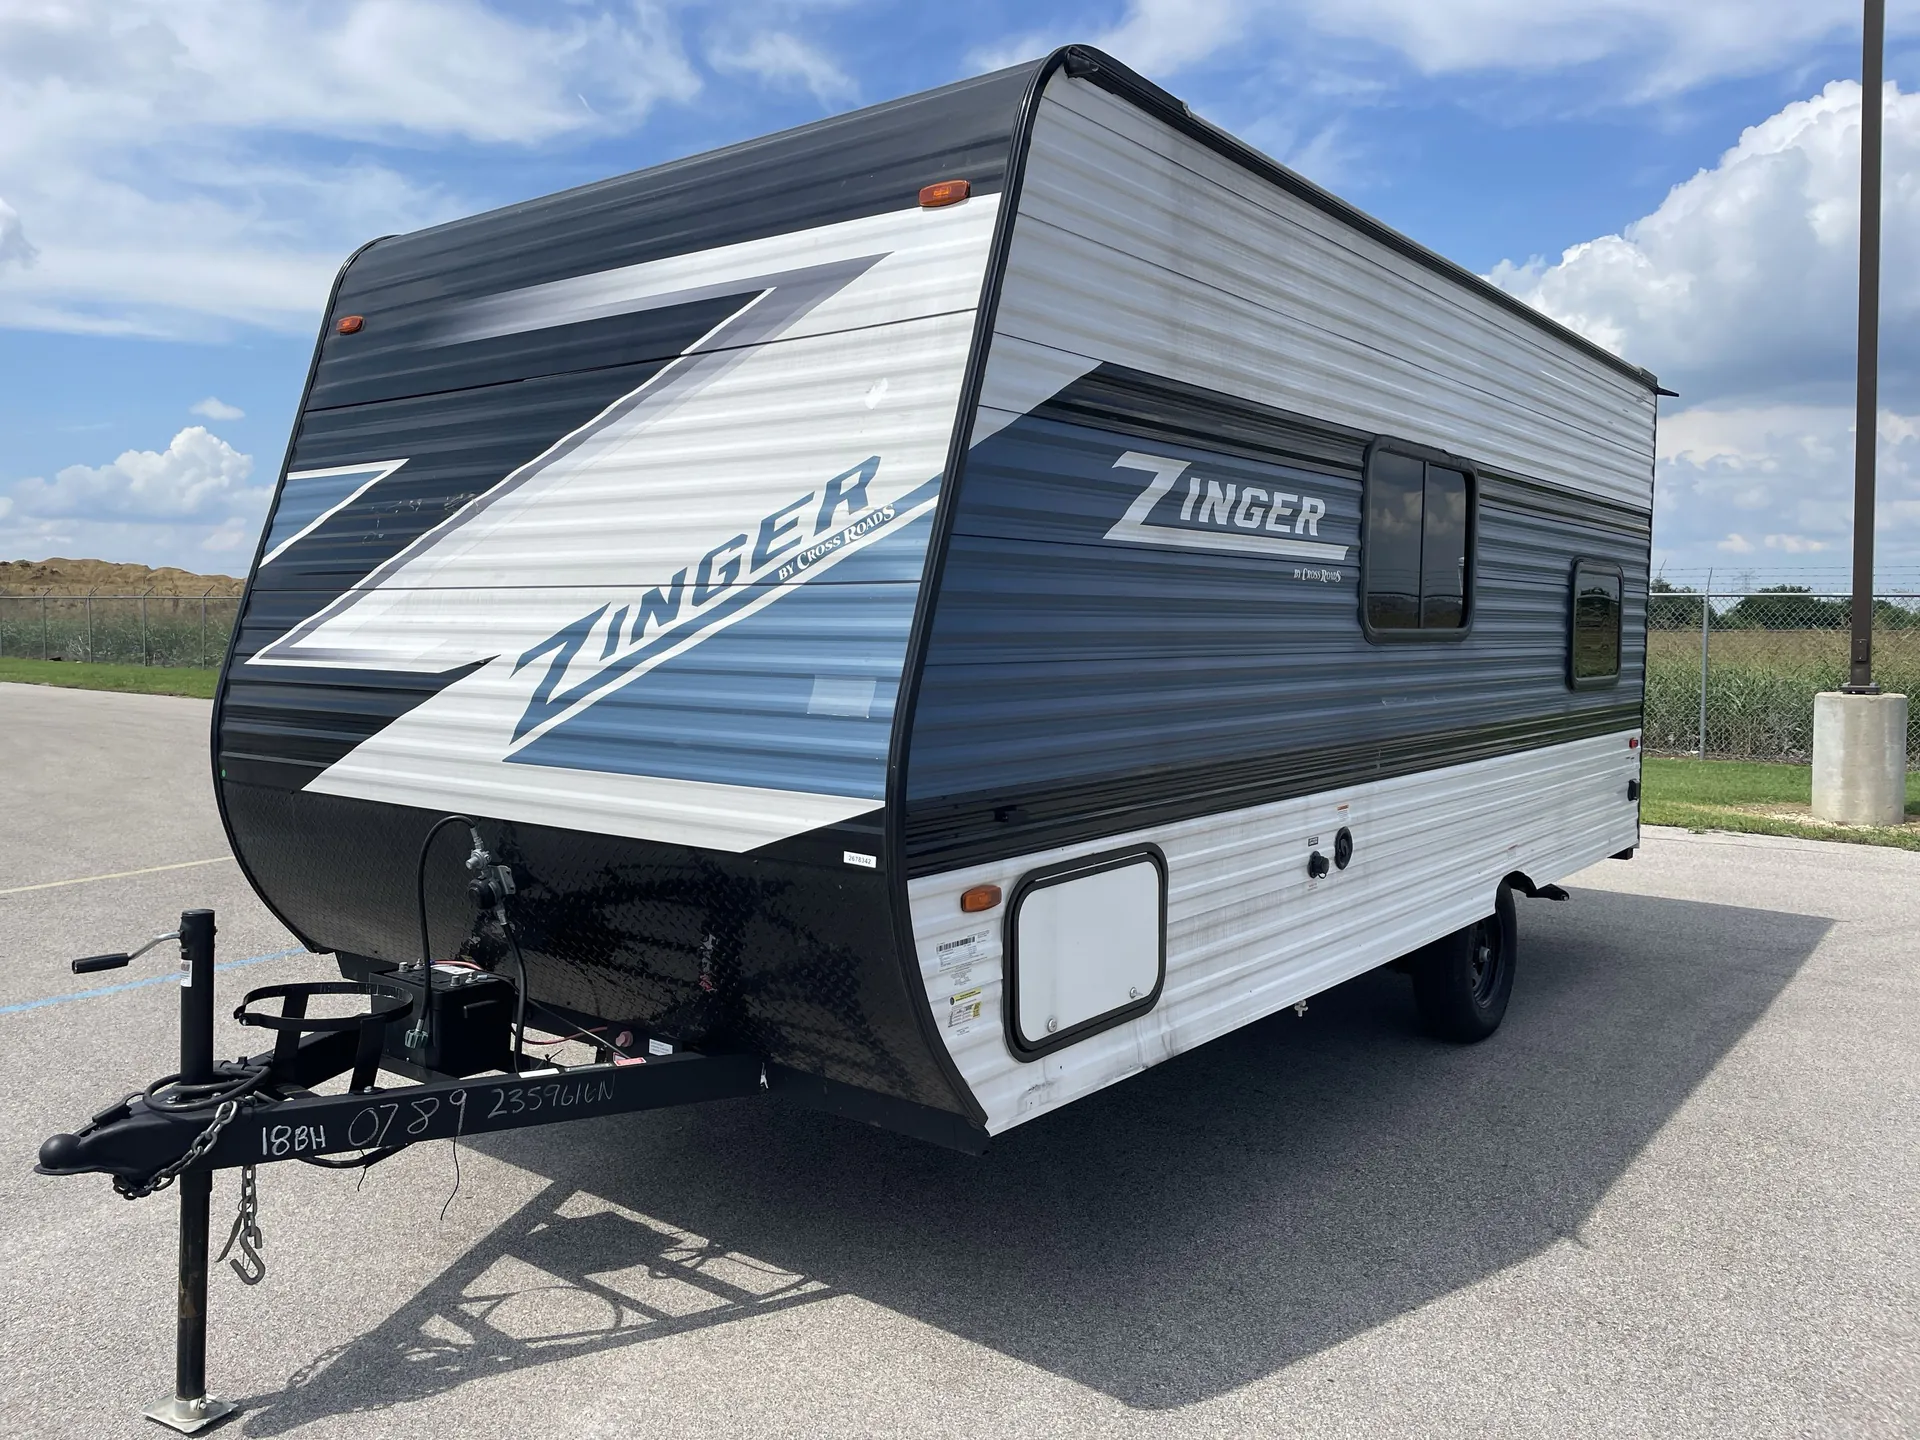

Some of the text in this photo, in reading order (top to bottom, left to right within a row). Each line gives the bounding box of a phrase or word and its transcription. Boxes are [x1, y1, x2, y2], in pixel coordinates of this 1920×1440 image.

[1103, 451, 1349, 560] ZINGER
[509, 456, 881, 745] ZINGER
[778, 562, 794, 580] BY
[262, 1125, 326, 1156] 18BH
